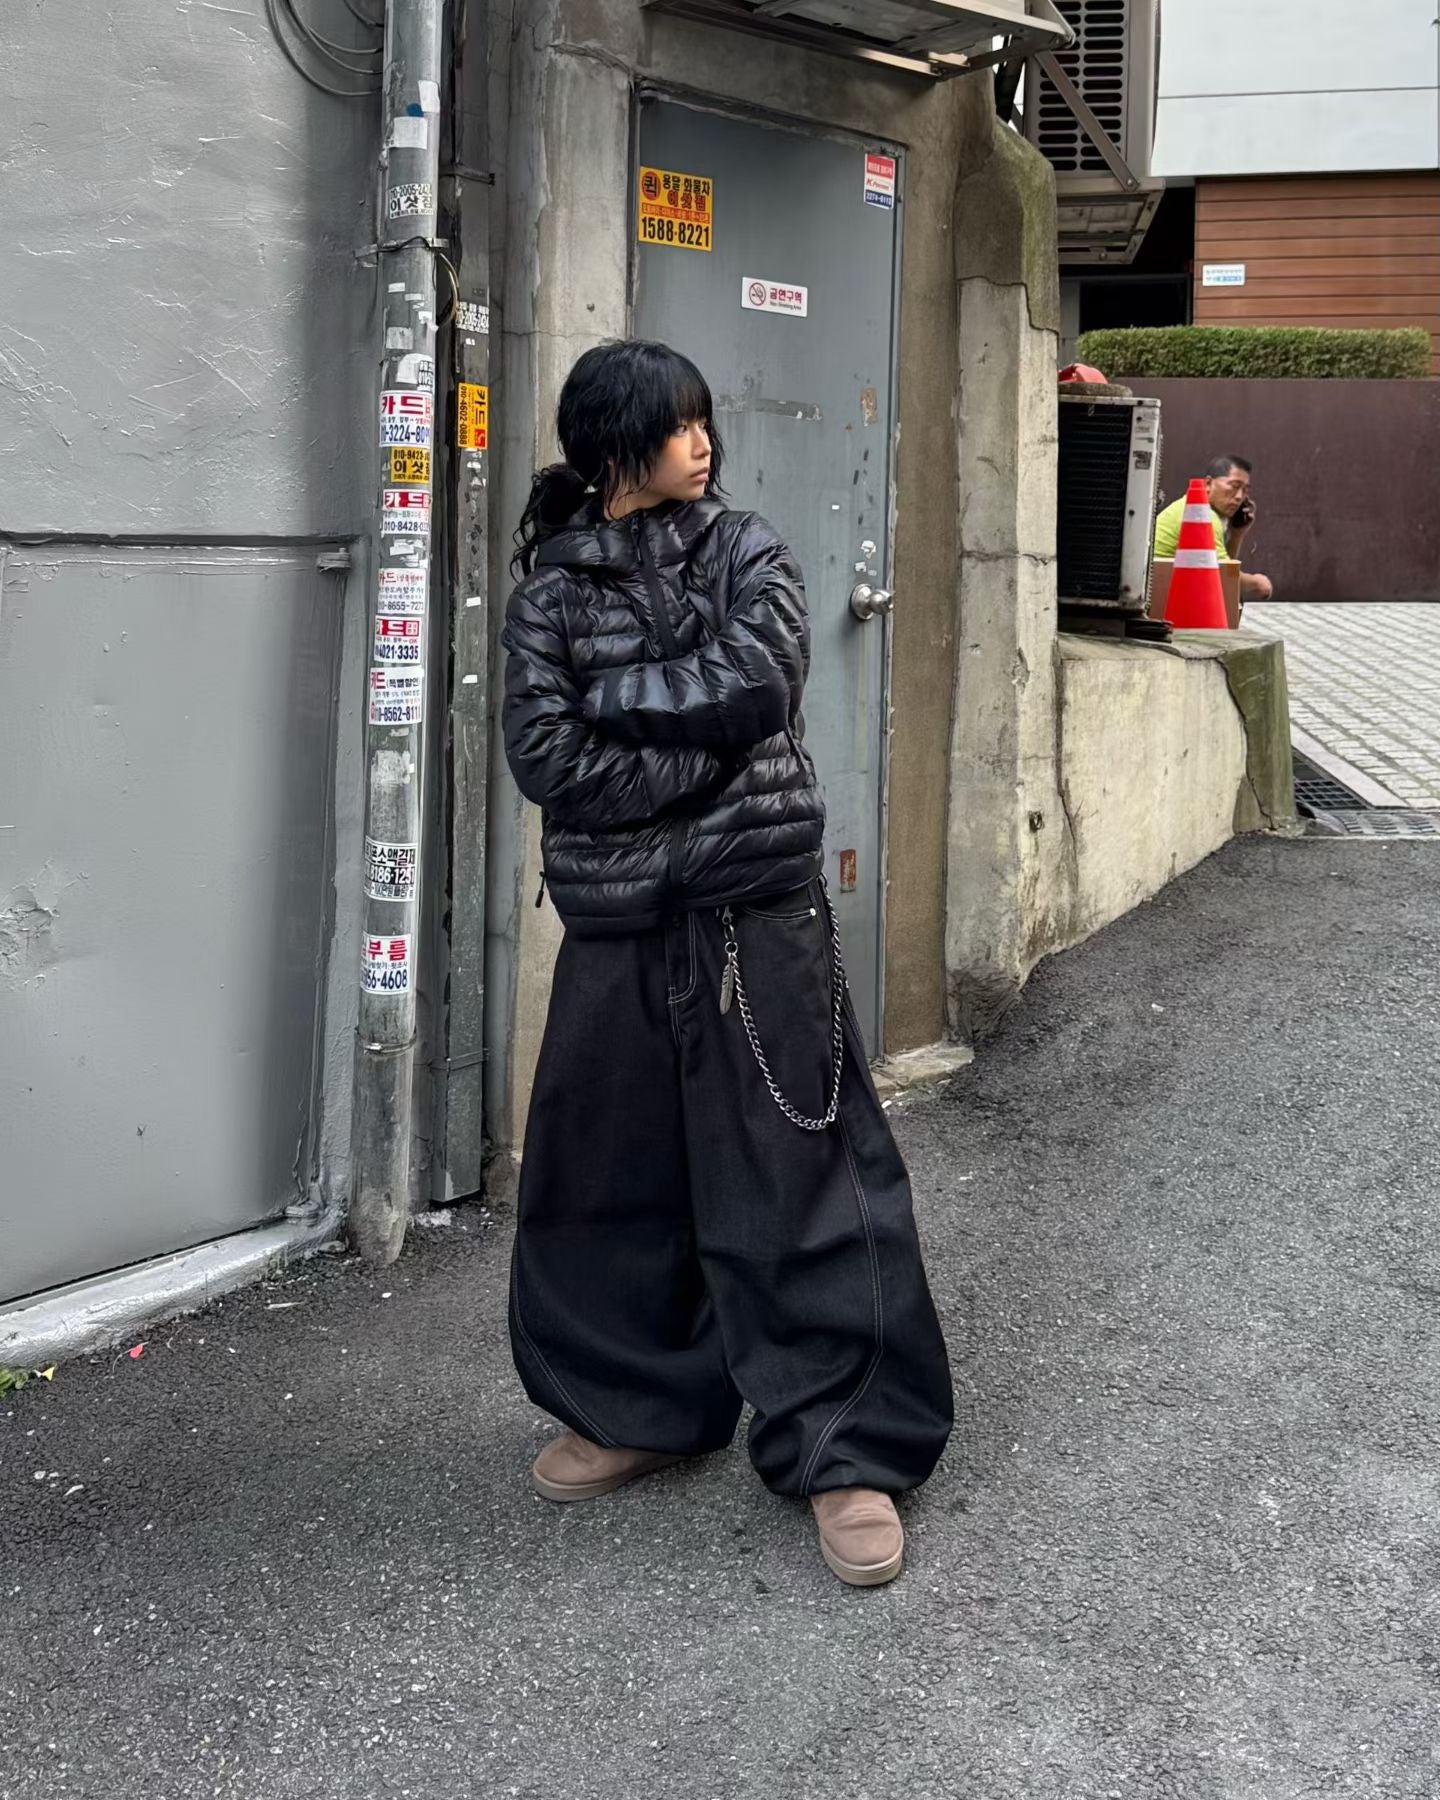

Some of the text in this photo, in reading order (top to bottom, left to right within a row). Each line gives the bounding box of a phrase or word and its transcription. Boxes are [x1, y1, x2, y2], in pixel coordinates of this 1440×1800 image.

[644, 175, 657, 197] 퀵
[769, 287, 802, 304] 금연구역
[381, 395, 424, 415] 카드
[475, 389, 486, 425] 카드
[385, 492, 423, 508] 카드
